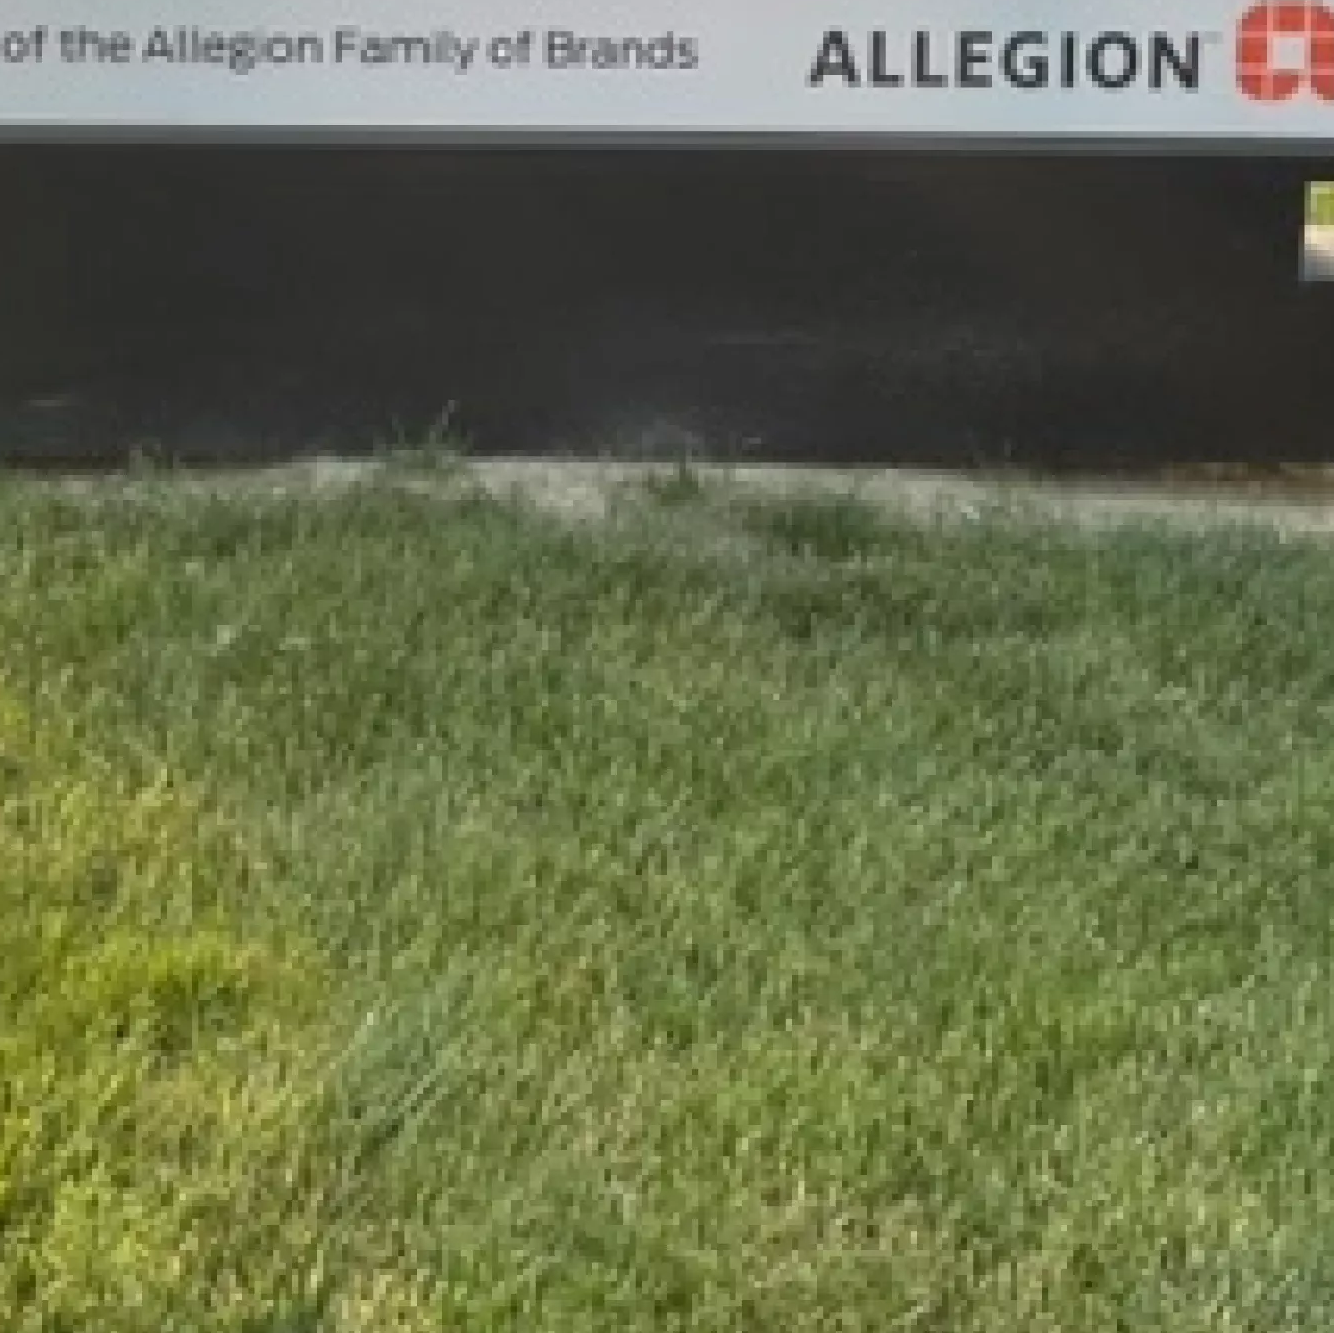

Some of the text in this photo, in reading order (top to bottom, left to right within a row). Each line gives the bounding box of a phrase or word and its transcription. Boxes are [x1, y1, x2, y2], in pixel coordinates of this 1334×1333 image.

[2, 25, 49, 63] of
[59, 27, 131, 64] the
[142, 25, 324, 76] Allegion
[334, 27, 476, 73] Family
[486, 29, 532, 68] of
[541, 30, 700, 70] Brands
[808, 30, 1200, 93] ALLEGION
